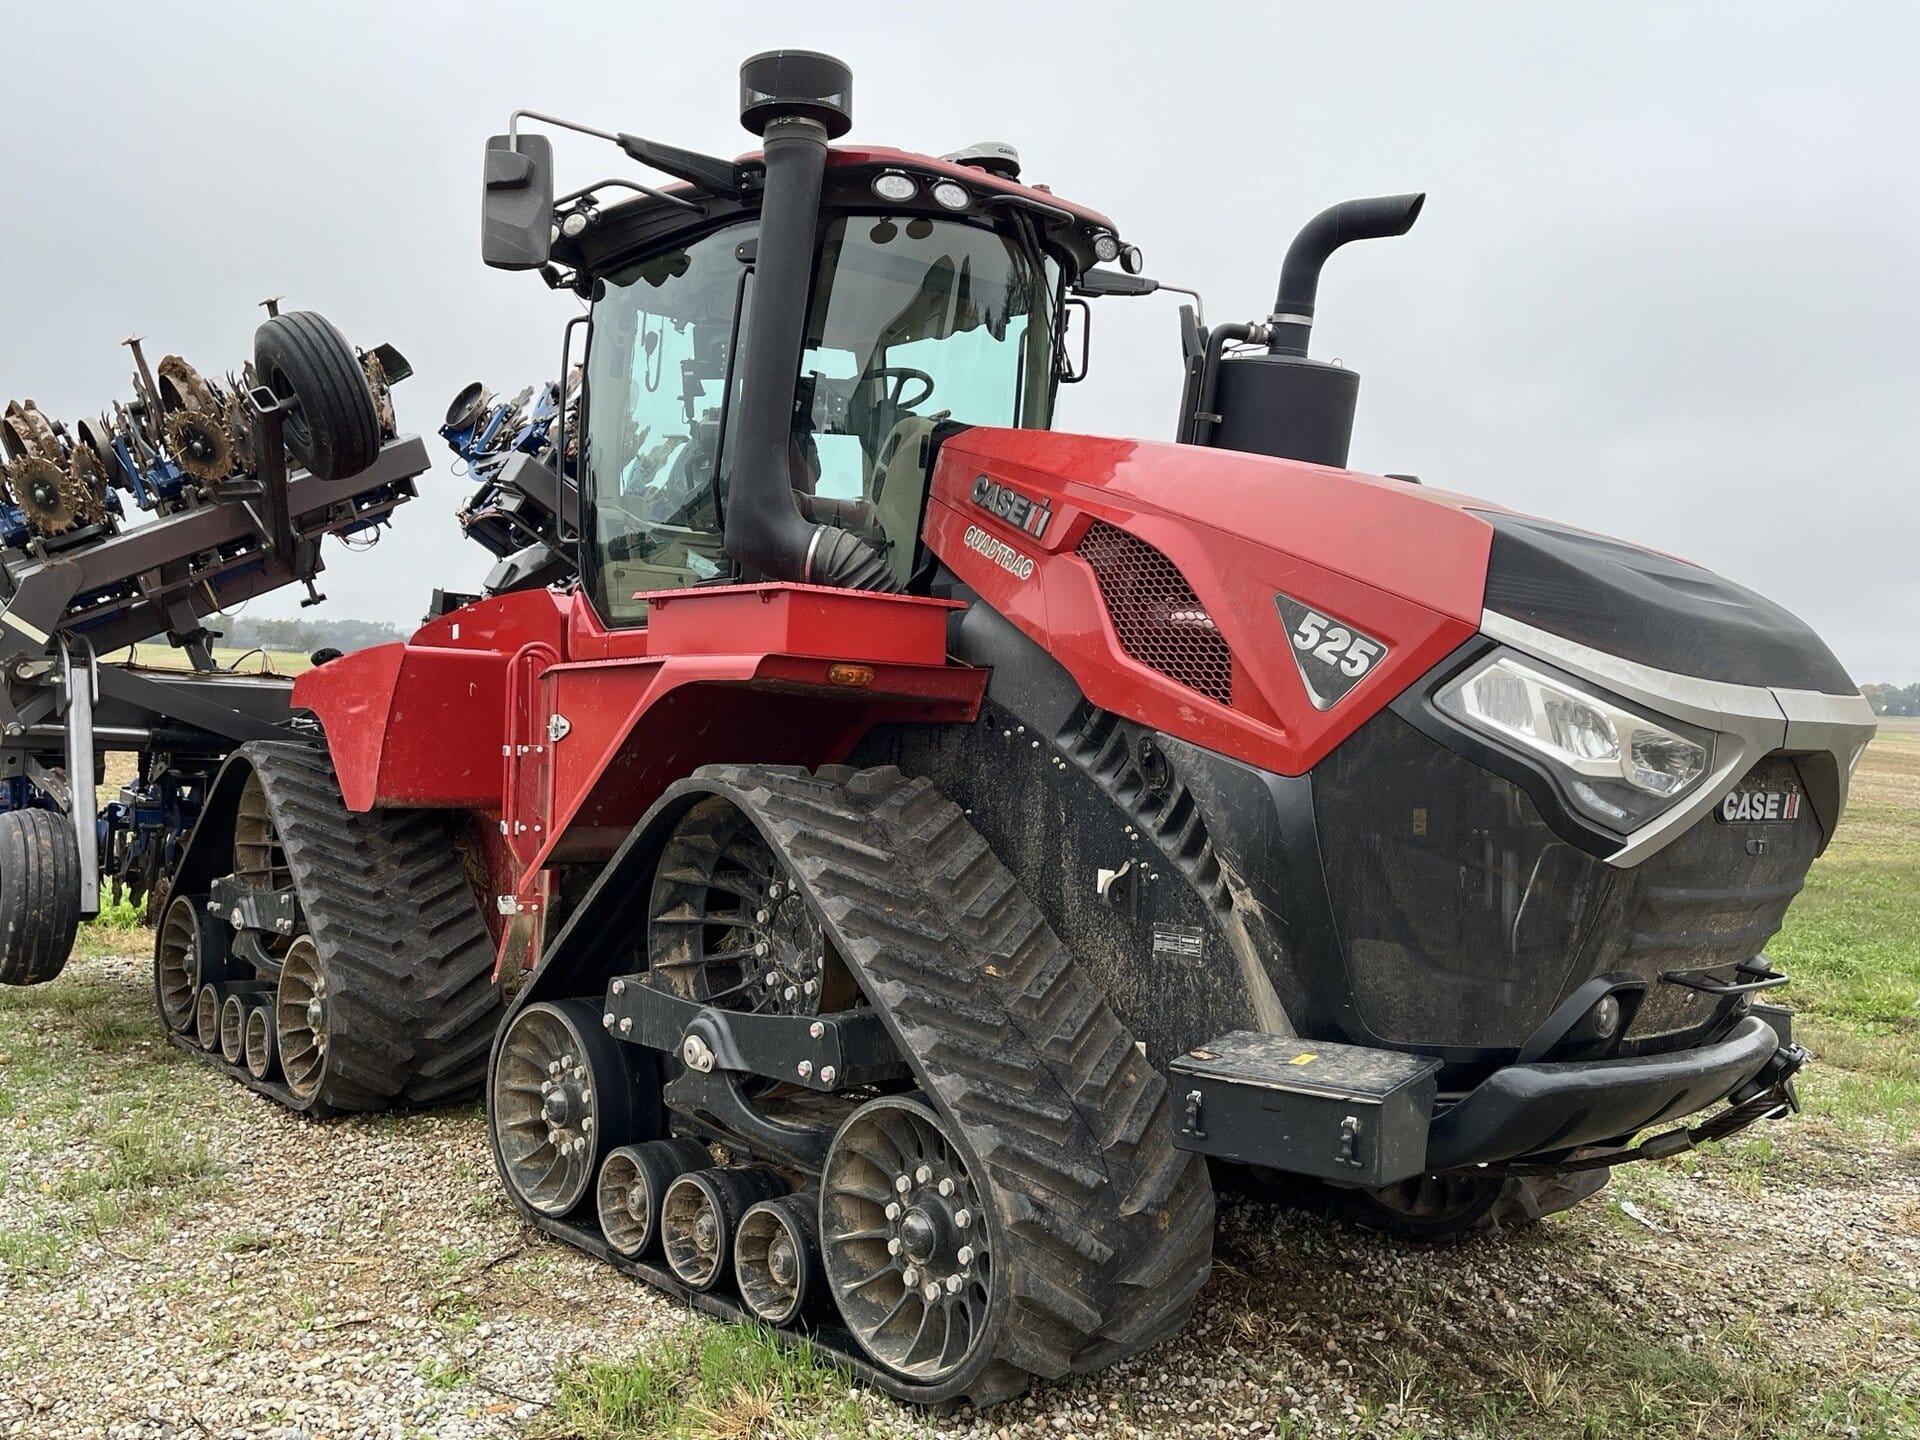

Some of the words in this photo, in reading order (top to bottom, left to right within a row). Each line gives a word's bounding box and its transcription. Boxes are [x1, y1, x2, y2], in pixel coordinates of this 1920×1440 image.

[971, 475, 1030, 527] CASE
[964, 525, 1034, 580] QUADTRAC
[1293, 611, 1379, 677] 525
[1723, 791, 1780, 820] CASE
